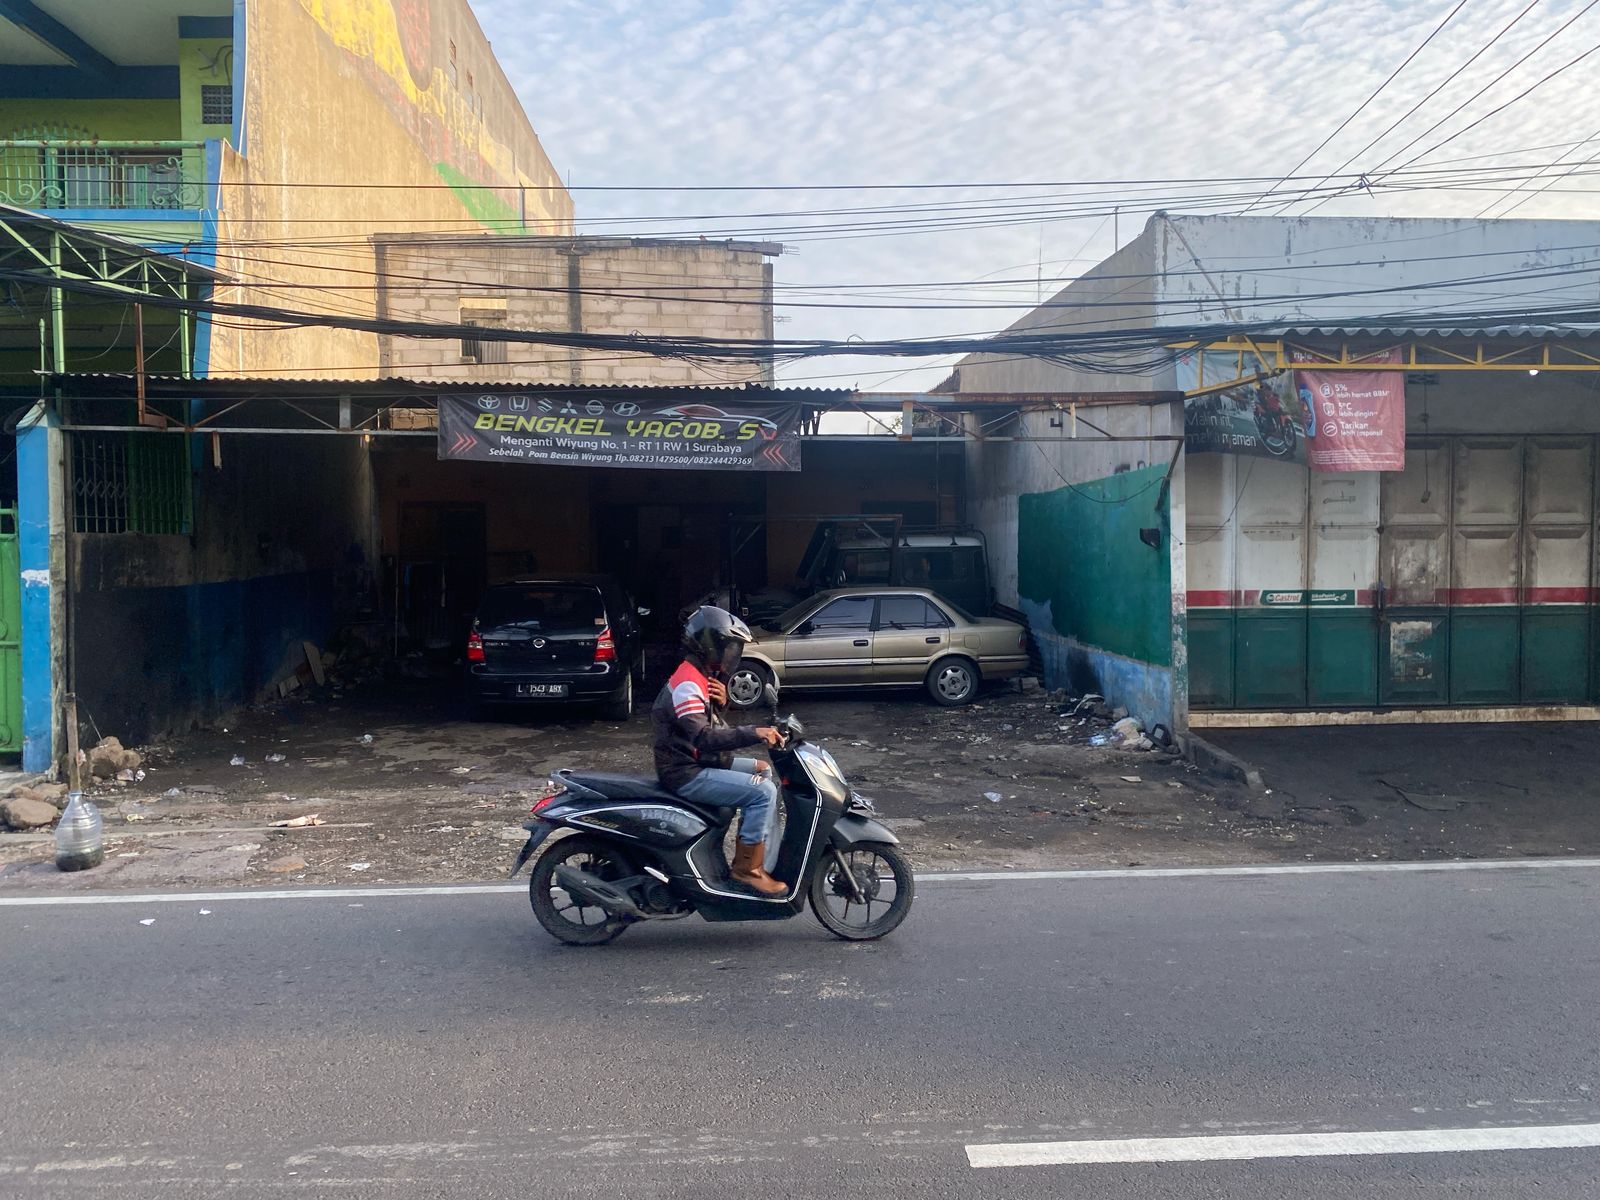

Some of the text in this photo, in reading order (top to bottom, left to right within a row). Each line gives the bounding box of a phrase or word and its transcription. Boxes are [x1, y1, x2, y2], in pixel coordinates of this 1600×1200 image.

[1335, 384, 1348, 392] 5%
[474, 413, 759, 440] BENGKEL YACOB. S
[500, 435, 553, 448] Menganti
[556, 437, 599, 450] Wiyung
[601, 439, 620, 449] No.
[622, 441, 627, 449] 1
[638, 442, 651, 450] RT
[656, 442, 660, 451] 1
[664, 443, 682, 451] RW
[685, 443, 689, 451] 1
[692, 443, 742, 455] Surabaya
[489, 447, 524, 457] Sebelah
[528, 451, 548, 459] Pom
[550, 451, 579, 461] Bensin
[581, 452, 612, 462] Wiyung
